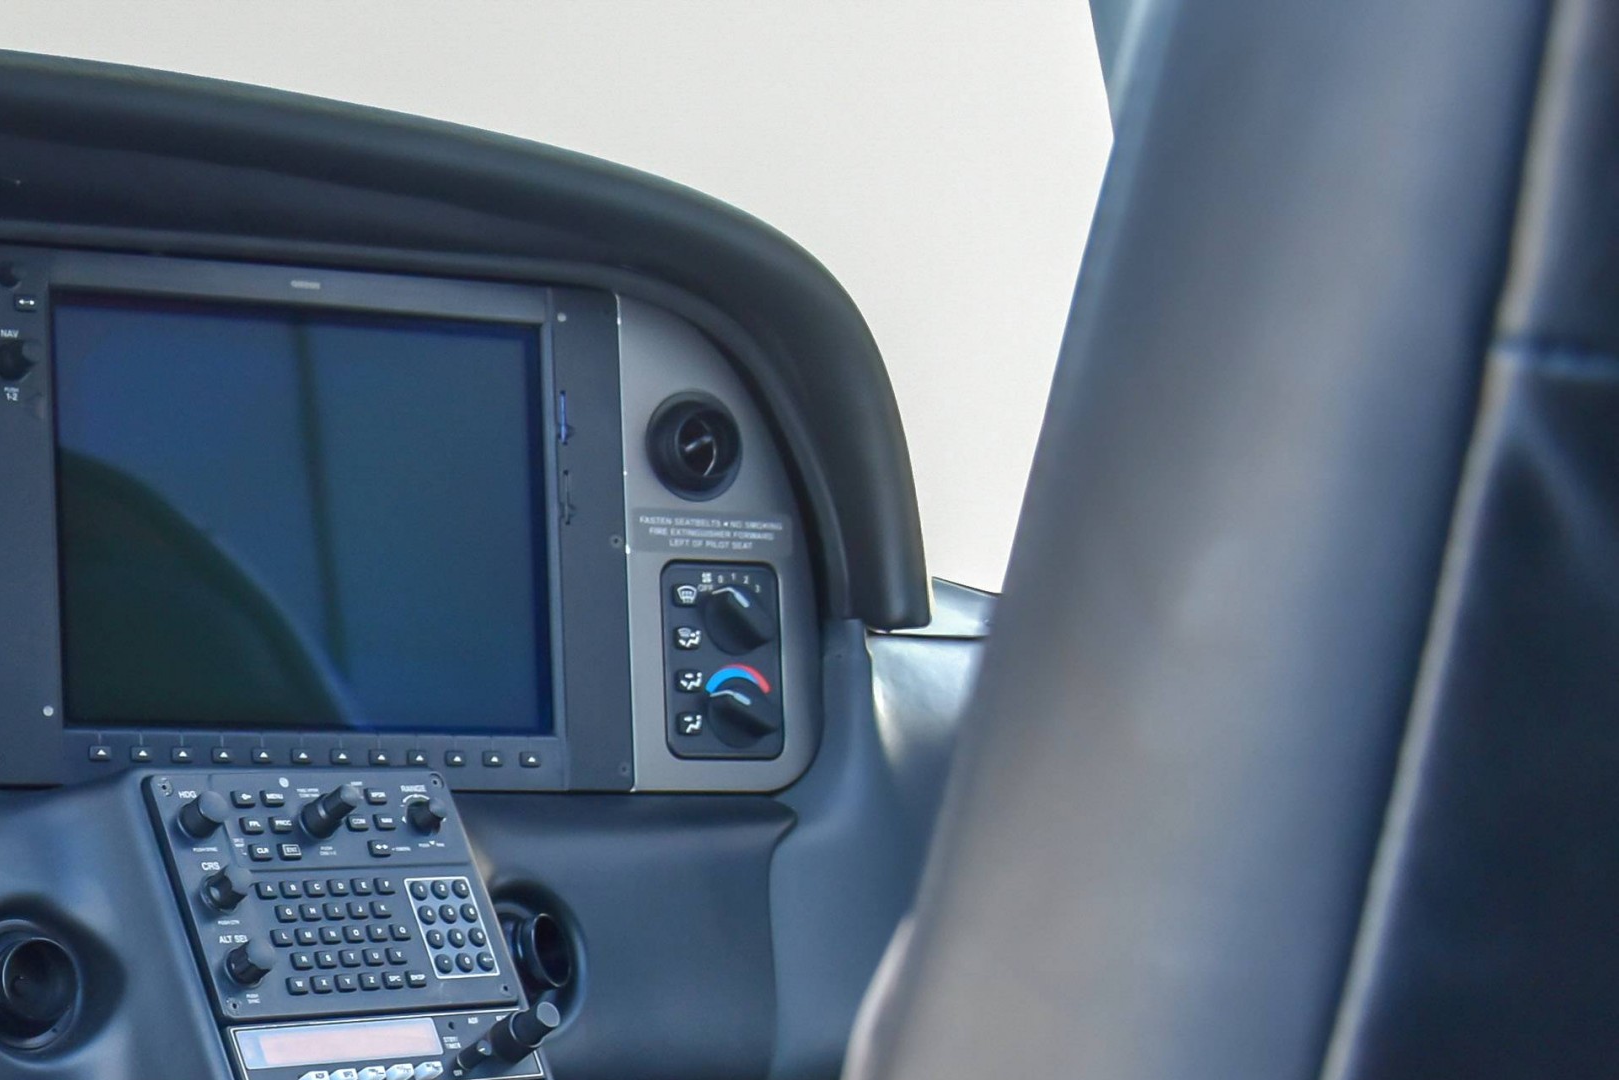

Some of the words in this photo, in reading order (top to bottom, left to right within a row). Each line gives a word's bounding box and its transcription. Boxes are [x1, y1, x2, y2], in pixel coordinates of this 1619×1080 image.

[0, 329, 19, 338] NAV
[640, 516, 672, 525] FASTEN
[674, 518, 720, 527] SEATBELTS
[179, 791, 196, 799] HDG
[201, 862, 220, 871] CRS
[219, 935, 232, 943] ALT
